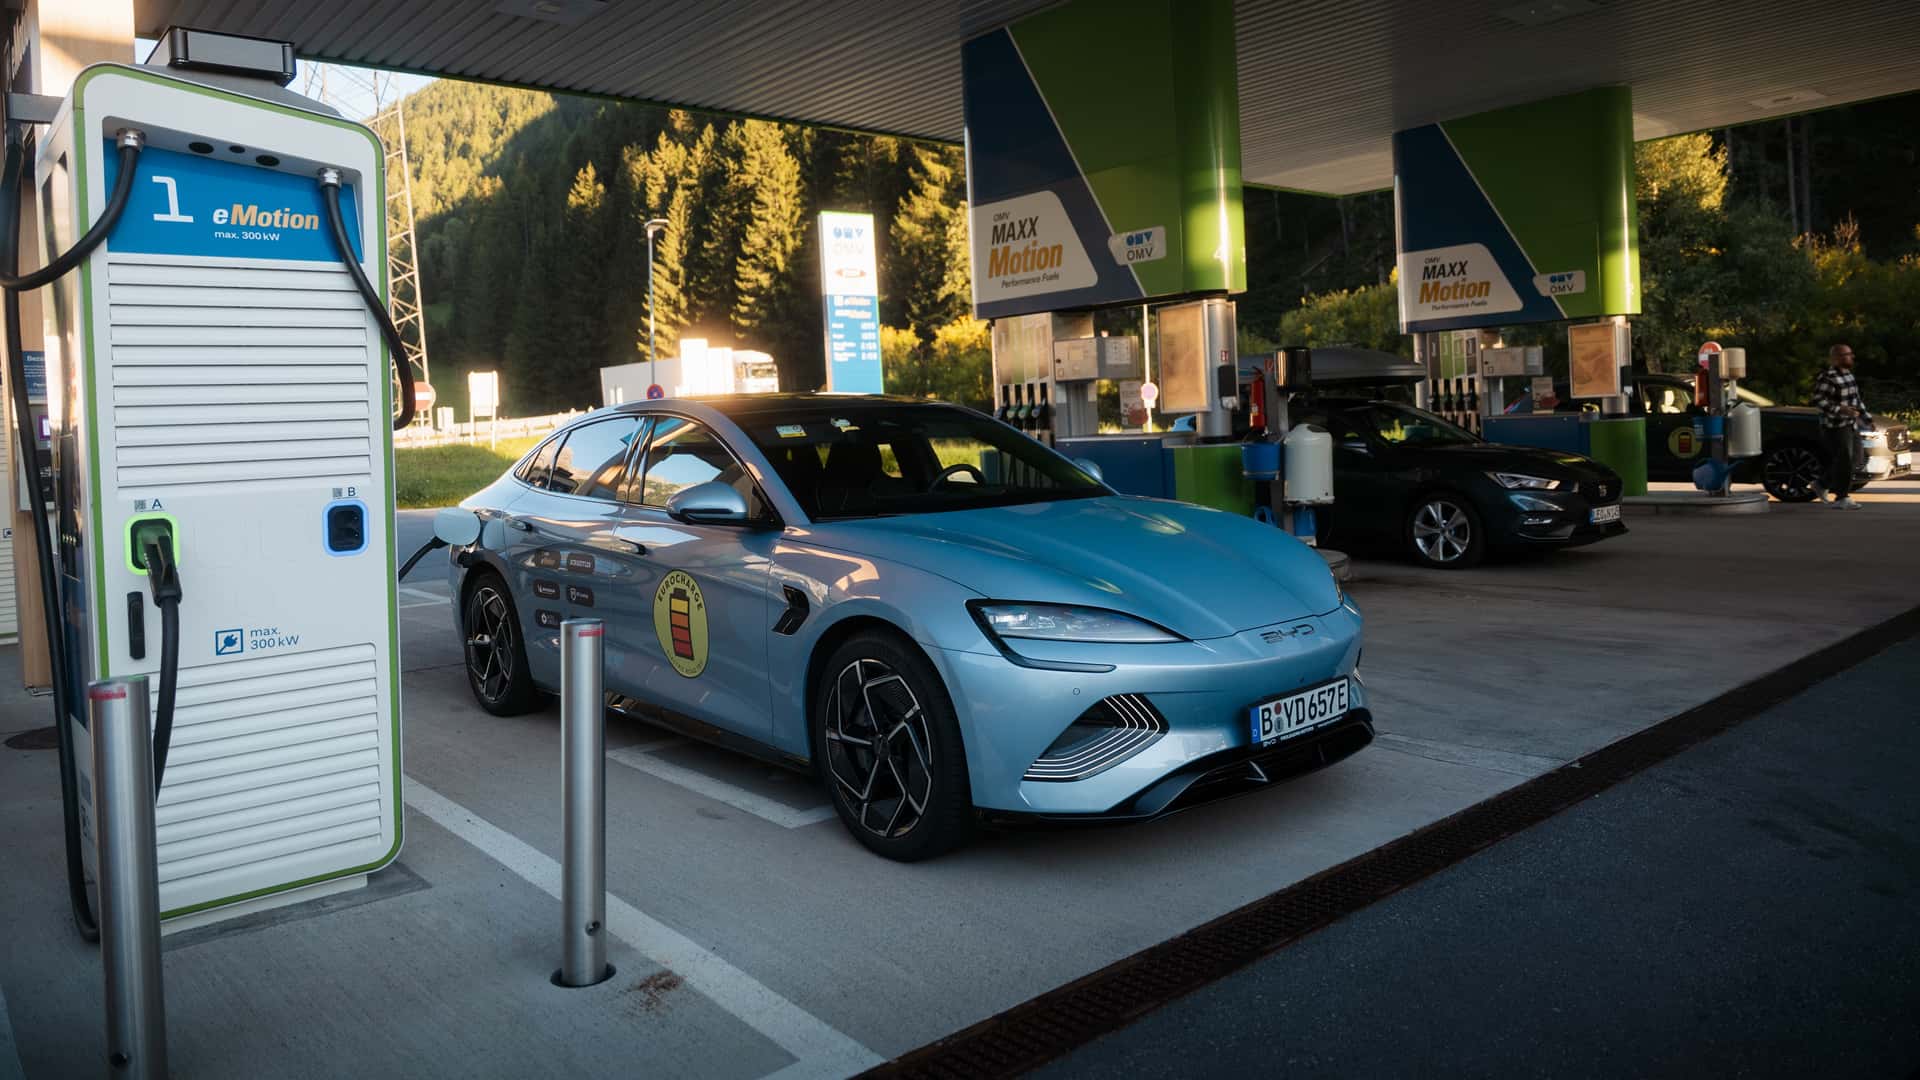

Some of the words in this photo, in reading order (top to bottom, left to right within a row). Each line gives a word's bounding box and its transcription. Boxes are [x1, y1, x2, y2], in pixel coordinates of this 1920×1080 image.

[152, 175, 194, 223] 1
[212, 203, 320, 231] eMotion
[214, 231, 239, 240] max.
[241, 231, 262, 240] 300
[263, 232, 280, 241] kW
[991, 215, 1039, 245] MAXX
[988, 240, 1063, 279] Motion
[1126, 247, 1153, 261] OMV
[1422, 260, 1468, 280] MAXX
[1001, 276, 1041, 288] Performance
[1418, 277, 1491, 304] Motion
[1550, 284, 1574, 293] OMV
[347, 487, 356, 497] B
[152, 499, 163, 510] A
[657, 574, 703, 611] EUROCHARGE
[250, 628, 281, 638] max.
[250, 638, 276, 650] 300
[278, 635, 300, 648] kW
[1260, 624, 1315, 645] BYD
[1261, 707, 1273, 736] B
